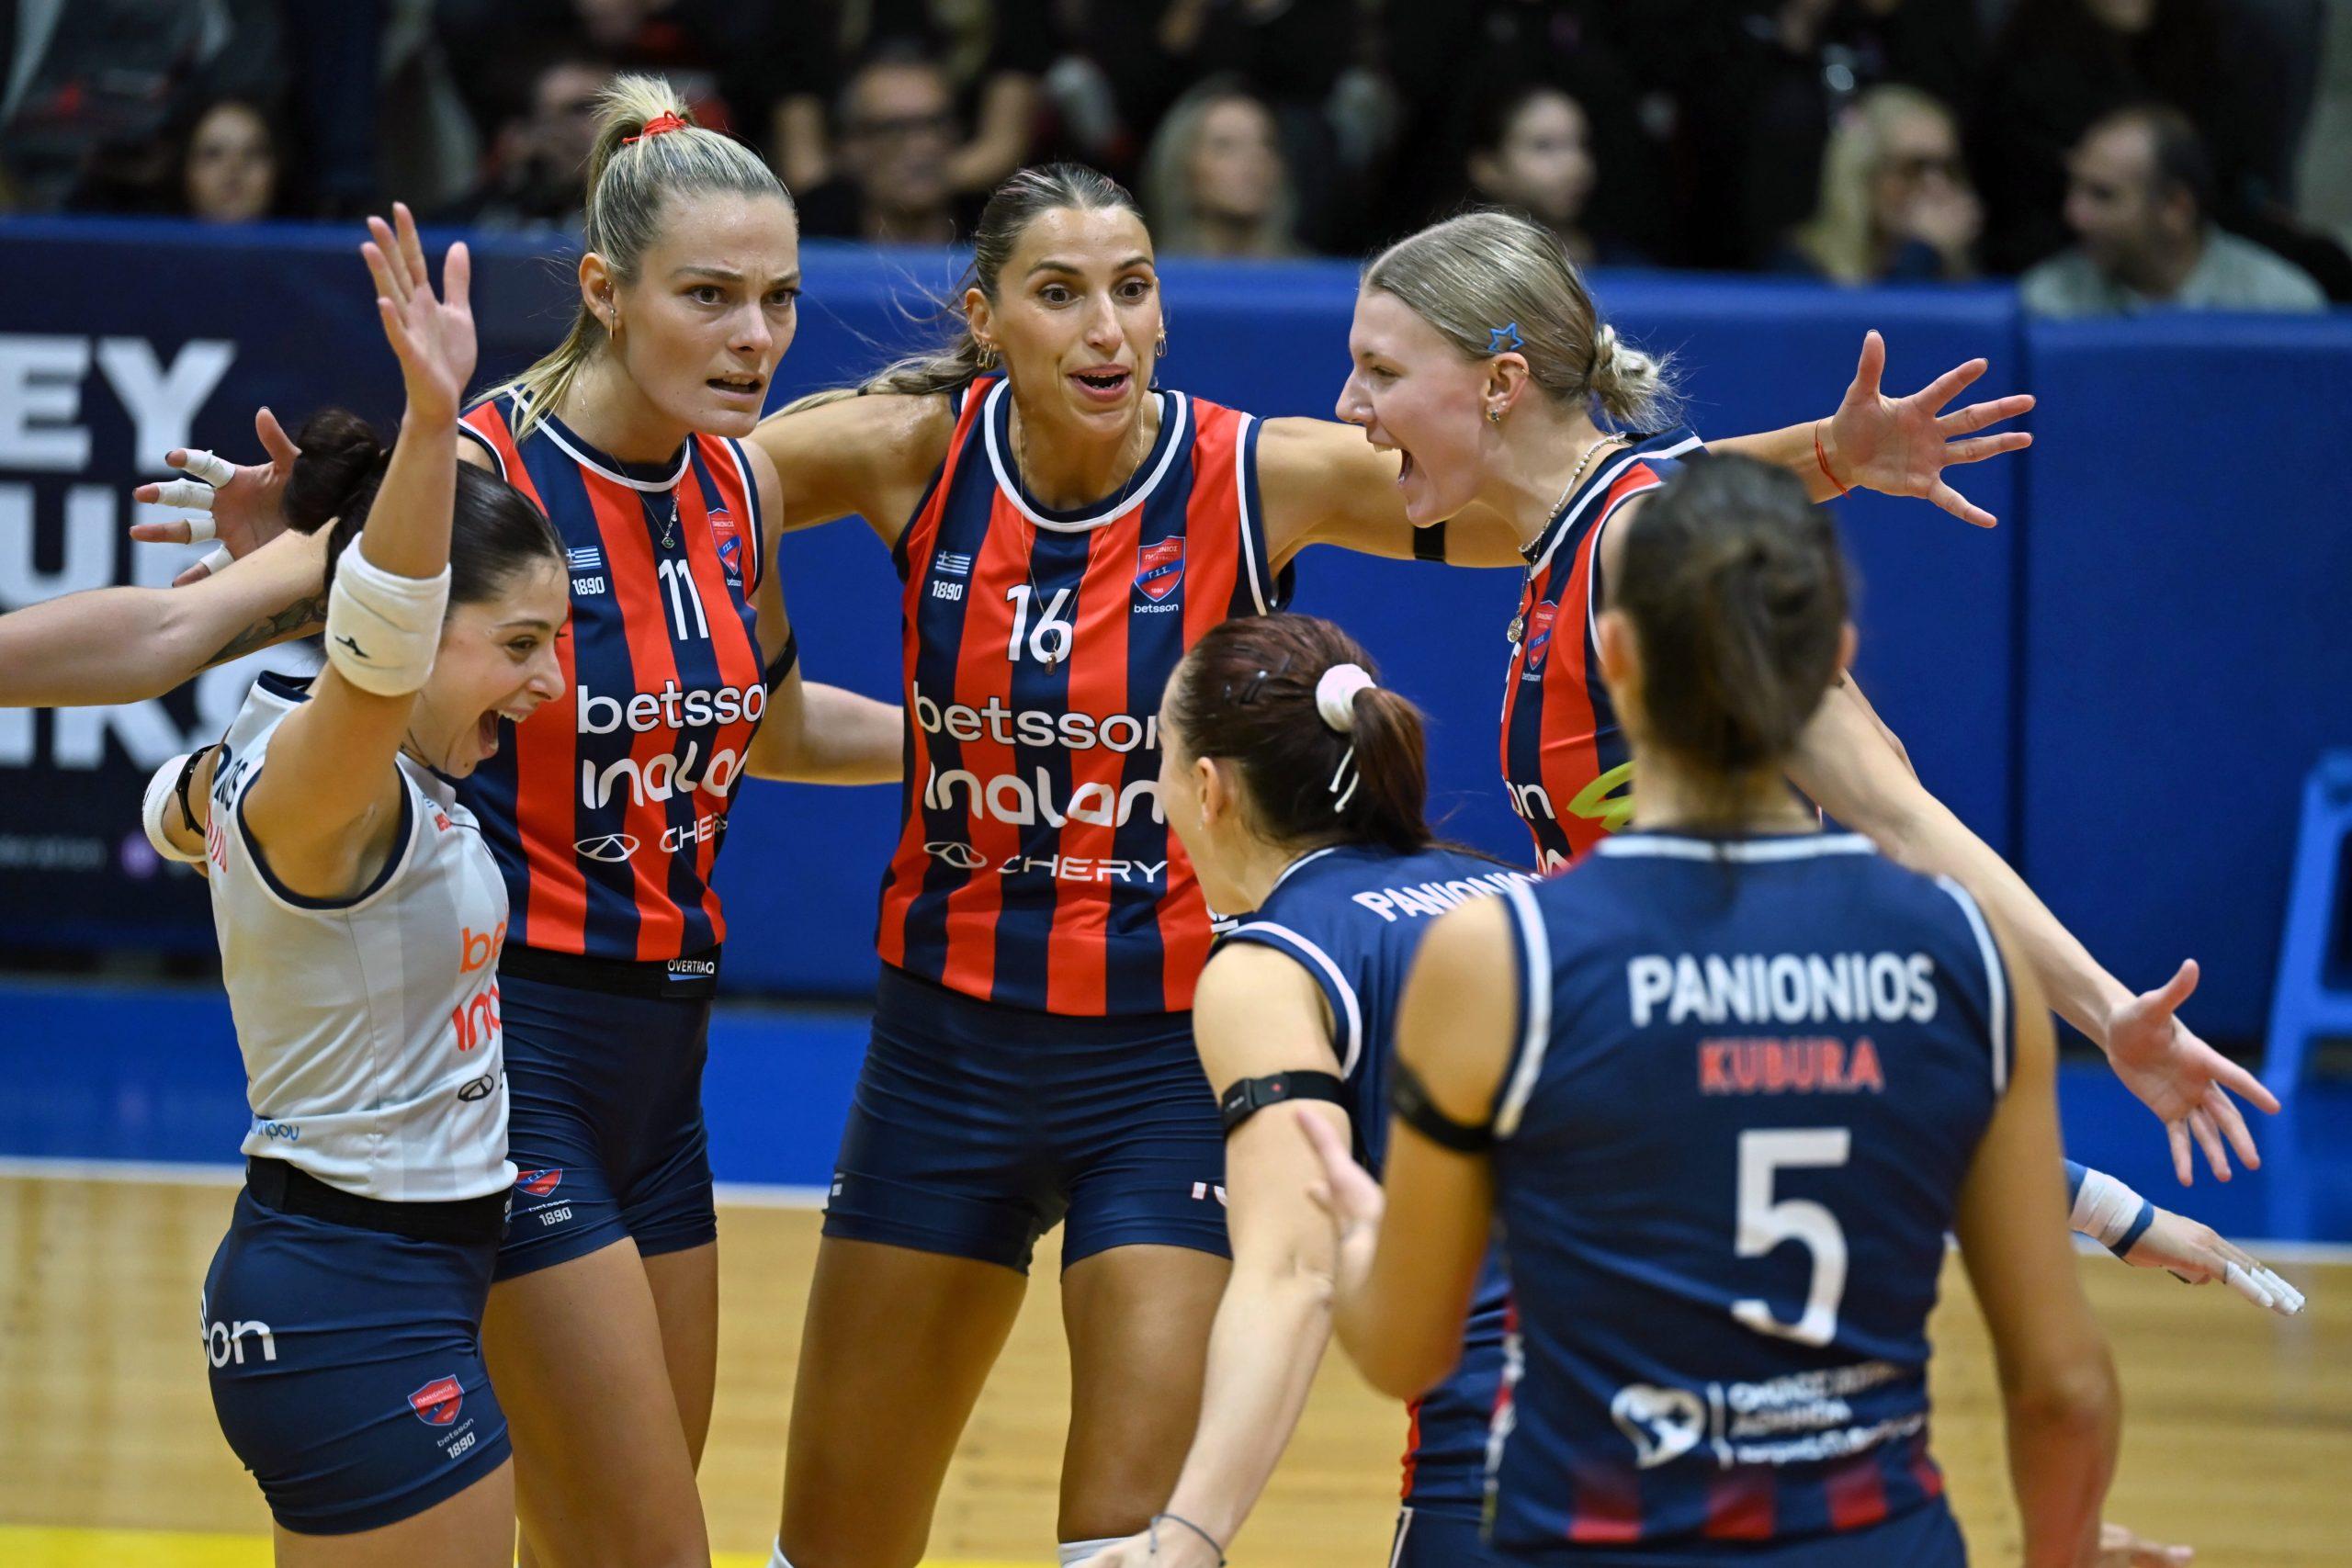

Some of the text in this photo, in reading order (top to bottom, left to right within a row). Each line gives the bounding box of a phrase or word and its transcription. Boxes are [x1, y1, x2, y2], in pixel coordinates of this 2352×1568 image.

[571, 576, 606, 596] 1890
[659, 558, 709, 640] 11
[932, 580, 964, 602] 1890
[1006, 583, 1074, 665] 16
[1133, 604, 1180, 614] betsson
[577, 680, 767, 735] betsso
[996, 854, 1169, 884] CHERY
[667, 959, 715, 974] OVERTRAQ
[1629, 953, 1938, 1027] PANIONIOS
[1699, 1038, 1884, 1093] KUBURA
[538, 1206, 572, 1226] 1890
[1732, 1126, 1851, 1348] 5
[436, 1417, 475, 1448] betsson
[447, 1431, 476, 1459] 1890
